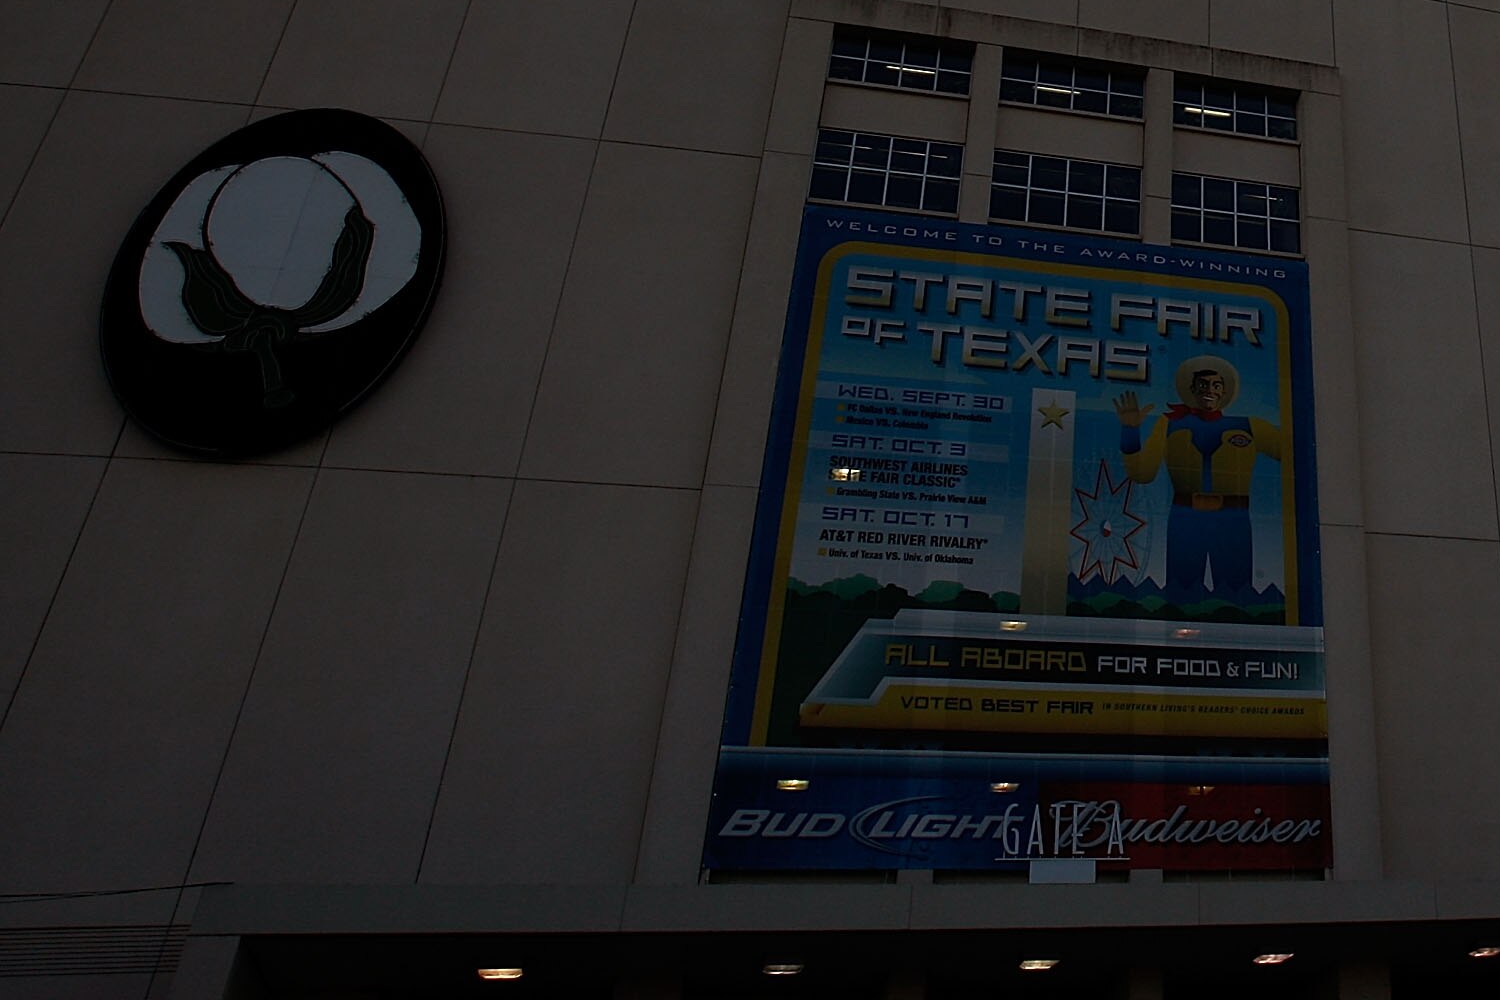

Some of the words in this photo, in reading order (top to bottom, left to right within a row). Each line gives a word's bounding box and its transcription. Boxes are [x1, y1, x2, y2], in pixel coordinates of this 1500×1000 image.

[826, 217, 958, 241] WELCOME
[972, 233, 1003, 246] TO
[1017, 239, 1066, 255] THE
[1079, 247, 1288, 280] AWARD-WINNING
[845, 265, 1092, 329] STATE
[1110, 293, 1262, 347] FAIR
[840, 316, 905, 346] OF
[917, 321, 1151, 382] TEXAS
[838, 384, 894, 401] WED.
[903, 390, 965, 407] SEPT.
[974, 396, 1003, 410] 30
[832, 434, 884, 449] SAT.
[891, 439, 942, 455] OCT.
[950, 443, 966, 456] 3
[829, 455, 907, 473] SOUTHWEST
[911, 462, 968, 476] AIRLINES
[871, 471, 899, 484] FAIR
[836, 487, 877, 499] Grambling
[879, 490, 900, 500] State
[902, 492, 917, 500] VS.
[919, 493, 946, 503] Prairie
[822, 506, 874, 522] SAT.
[883, 511, 935, 526] OCT.
[944, 514, 969, 528] 17
[819, 529, 856, 542] AT&T
[857, 531, 884, 544] RED
[887, 533, 926, 547] RIVER
[828, 548, 849, 558] Univ.
[850, 551, 859, 559] of
[861, 551, 883, 560] Texas
[885, 552, 901, 561] VS.
[903, 553, 923, 562] Univ.
[924, 554, 933, 562] of
[934, 555, 974, 565] Oklahoma
[884, 643, 949, 667] ALL
[960, 646, 1088, 672] ABOARD
[1098, 656, 1147, 674] FOR
[1157, 658, 1221, 677] FOOD
[1226, 663, 1240, 677] &
[1244, 661, 1298, 680] FUN!
[901, 695, 973, 711] VOTED
[981, 698, 1039, 713] BEST
[1047, 700, 1094, 715] FAIR
[1114, 703, 1157, 712] SOUTHERN
[1240, 706, 1269, 715] CHOICE
[1272, 706, 1305, 715] AWARDS
[718, 808, 847, 838] BUD
[867, 810, 1026, 839] LIGHT
[1003, 803, 1085, 855] GATE
[1107, 803, 1125, 855] A
[1049, 800, 1322, 848] Budweiser
